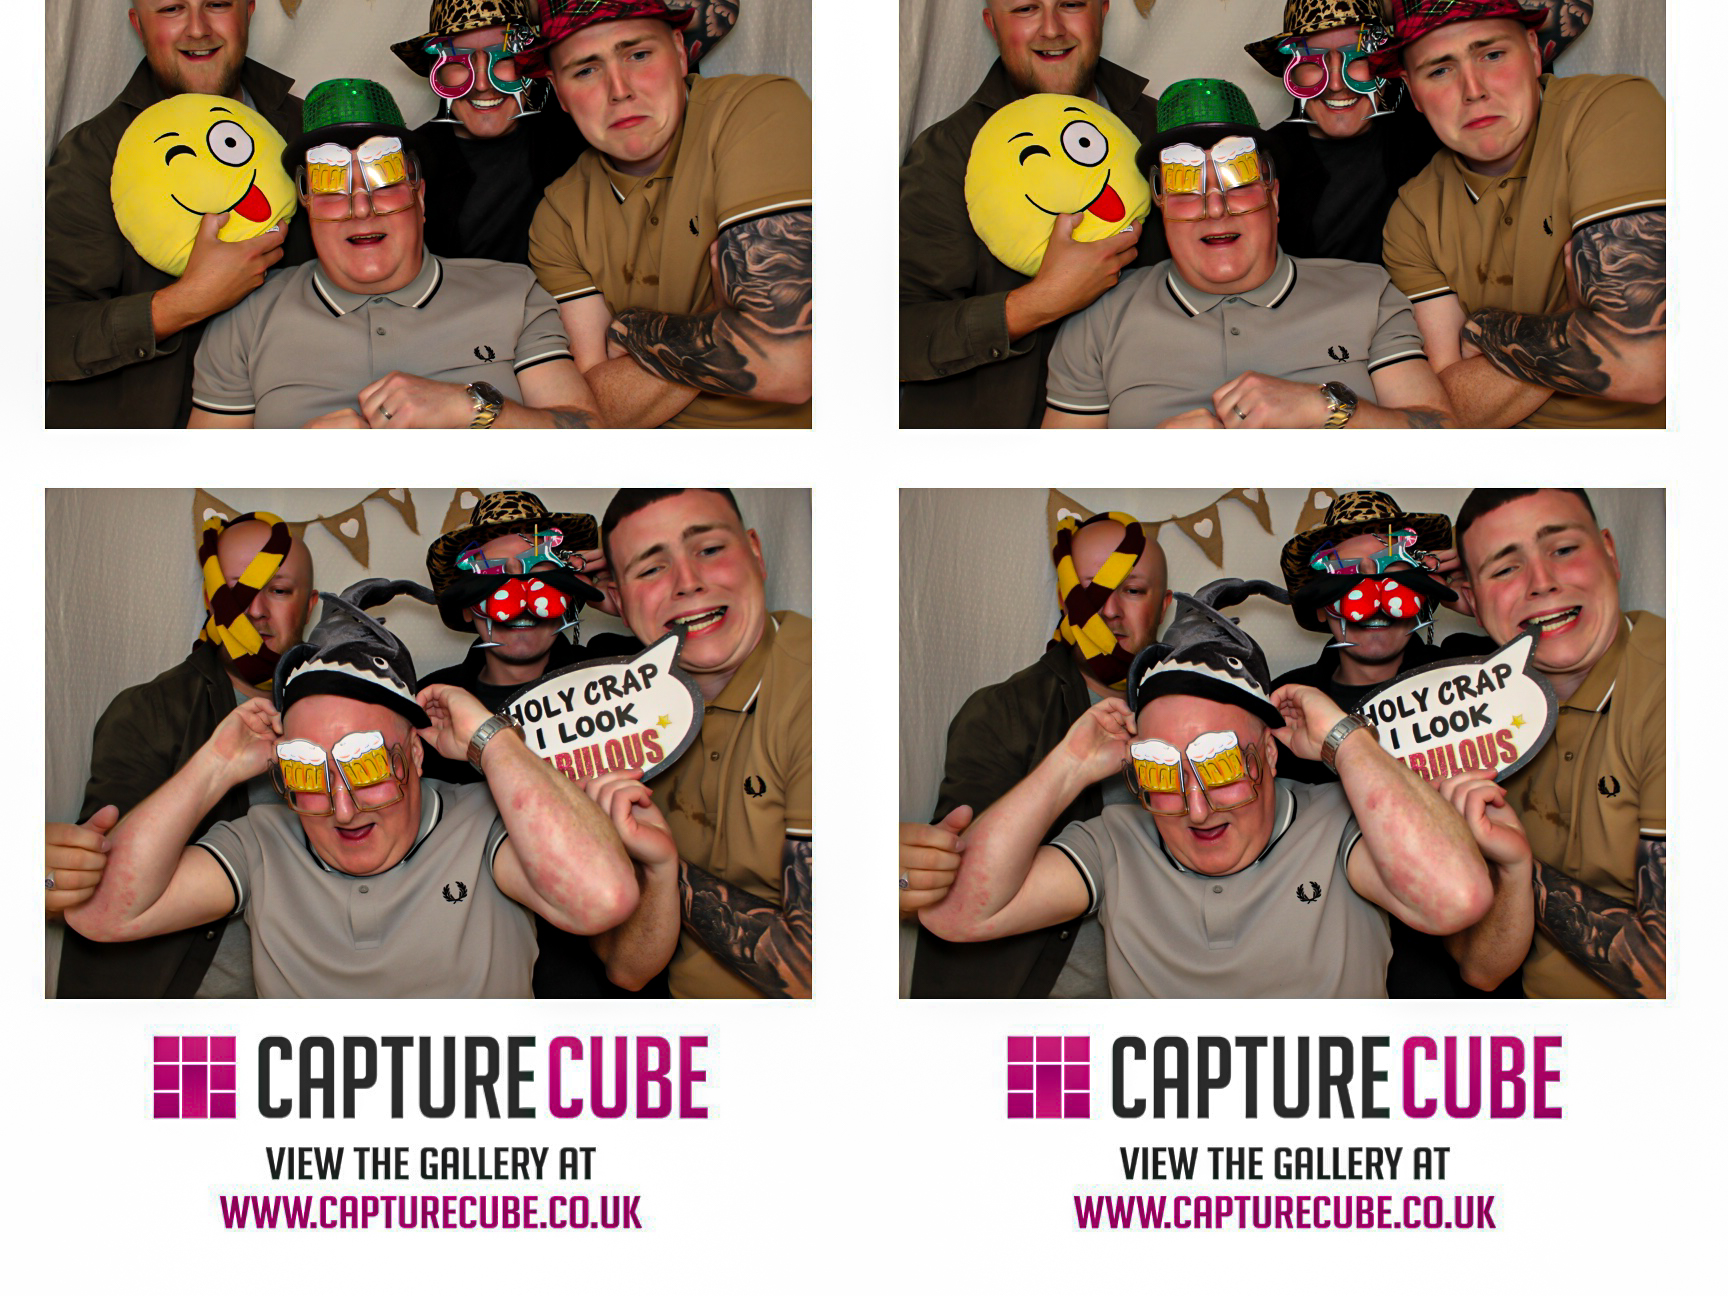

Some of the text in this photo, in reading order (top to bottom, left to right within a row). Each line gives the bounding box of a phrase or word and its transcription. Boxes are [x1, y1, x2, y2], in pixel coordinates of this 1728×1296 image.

[584, 663, 658, 706] CRAP
[1438, 663, 1512, 706] CRAP
[536, 702, 639, 750] I LOOK
[1390, 702, 1493, 750] I LOOK
[543, 728, 664, 781] BULOUS
[1397, 728, 1518, 781] BULOUS
